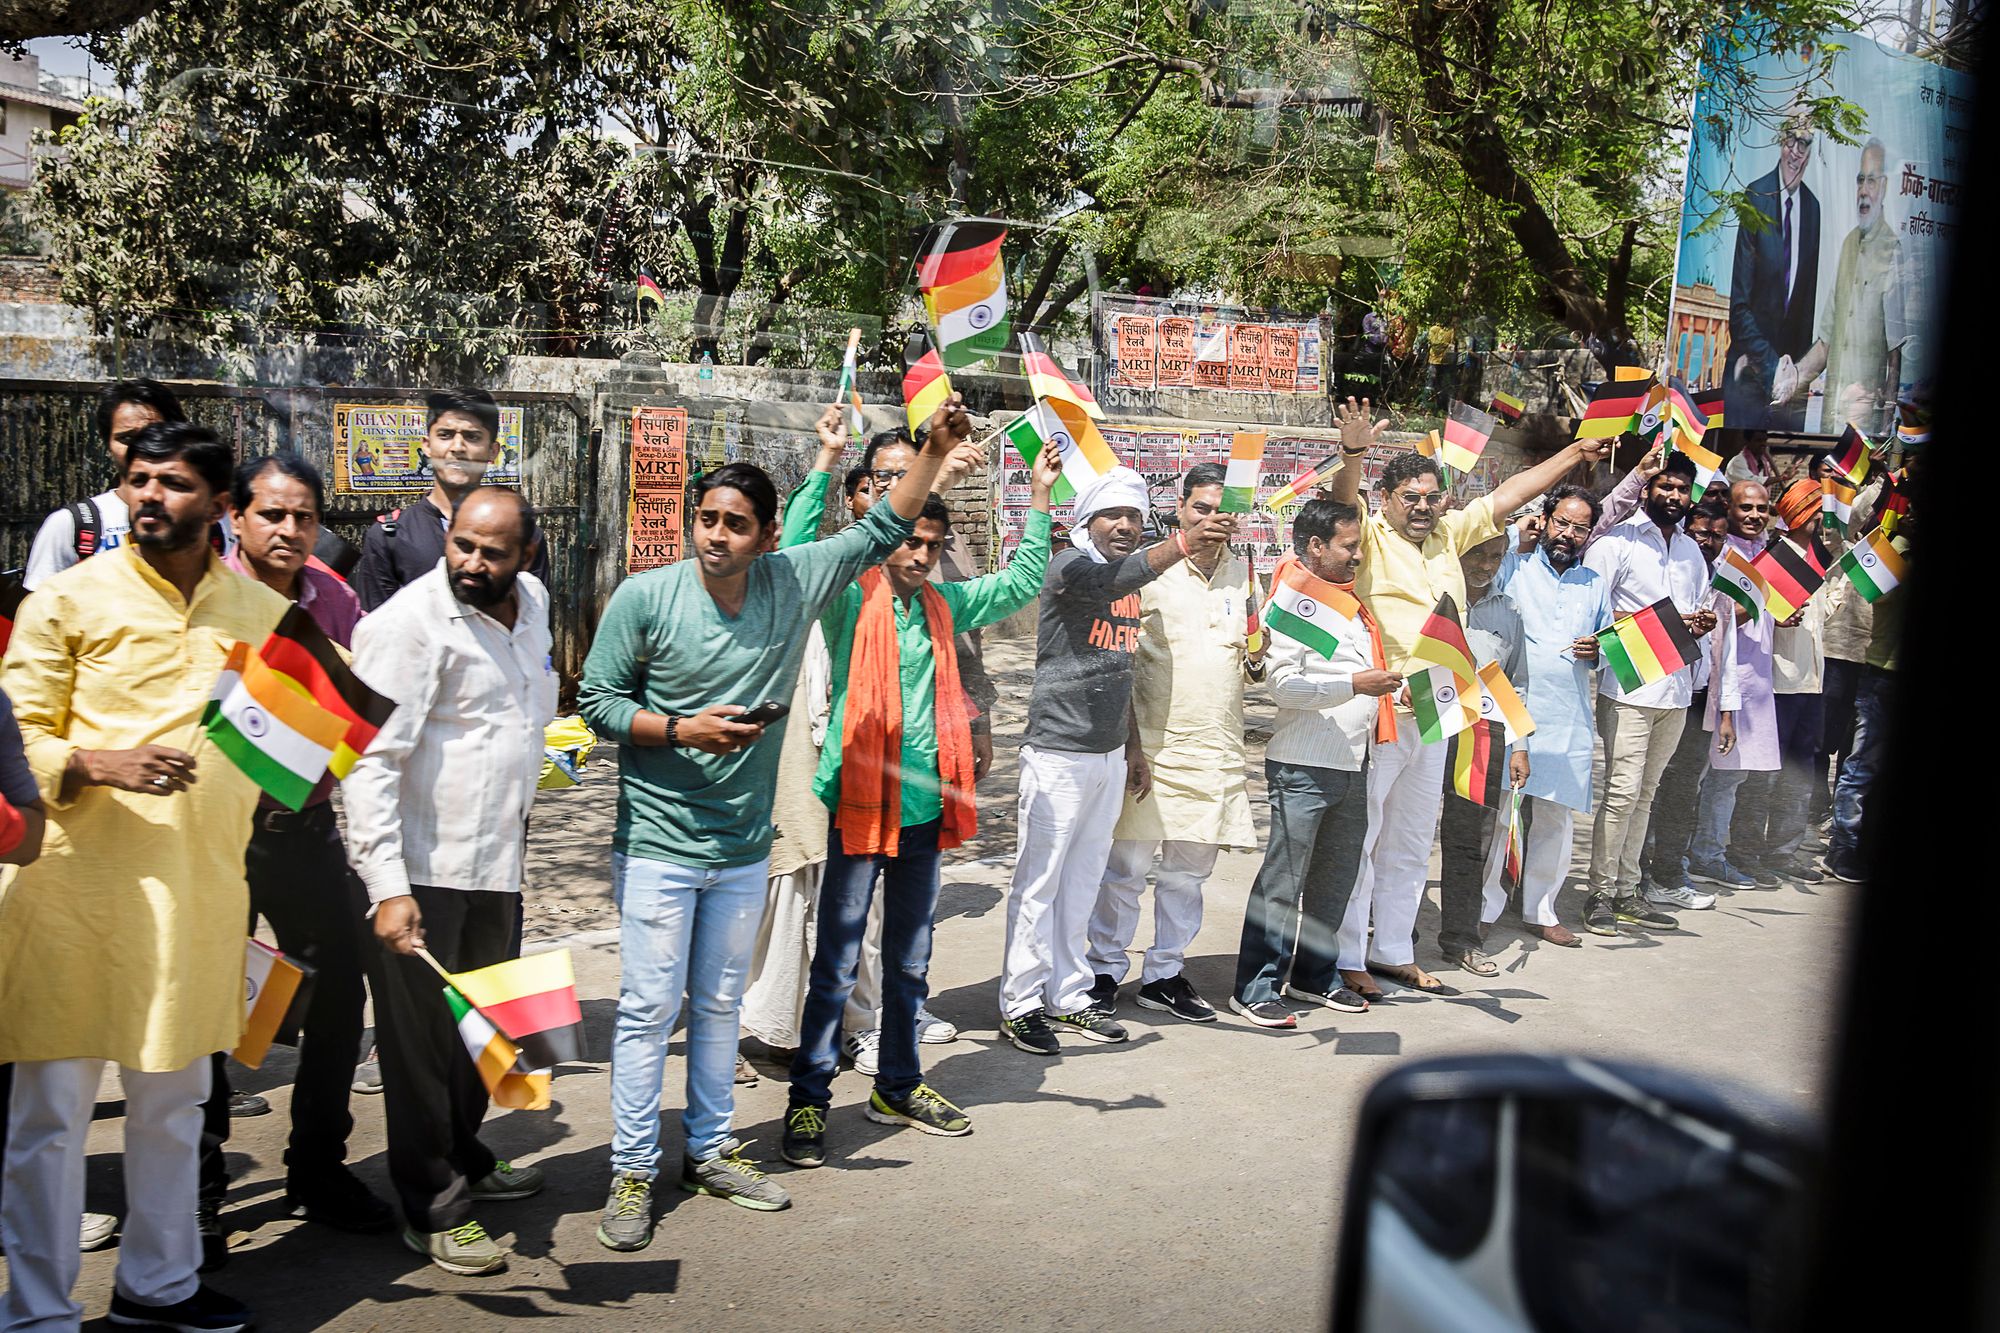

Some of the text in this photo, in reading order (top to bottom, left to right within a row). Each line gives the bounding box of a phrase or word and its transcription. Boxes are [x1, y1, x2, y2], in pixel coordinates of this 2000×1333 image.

[1909, 211, 1934, 237] हार्दिक
[1122, 321, 1150, 336] सिपाही
[1163, 323, 1189, 338] सिपाही
[1126, 335, 1145, 347] रेलवे
[1166, 337, 1184, 348] रेलवे
[1121, 359, 1151, 370] MRT
[1161, 359, 1190, 371] MRT
[1197, 364, 1226, 376] MRT
[1234, 365, 1262, 377] MRT
[1267, 367, 1295, 380] MRT
[355, 413, 397, 426] KHAN
[638, 413, 680, 431] सिपाही
[643, 431, 670, 446] रेलवे
[634, 460, 680, 475] MRT
[636, 498, 677, 514] सिपाही
[640, 515, 668, 528] रेलवे
[631, 544, 678, 558] MRT
